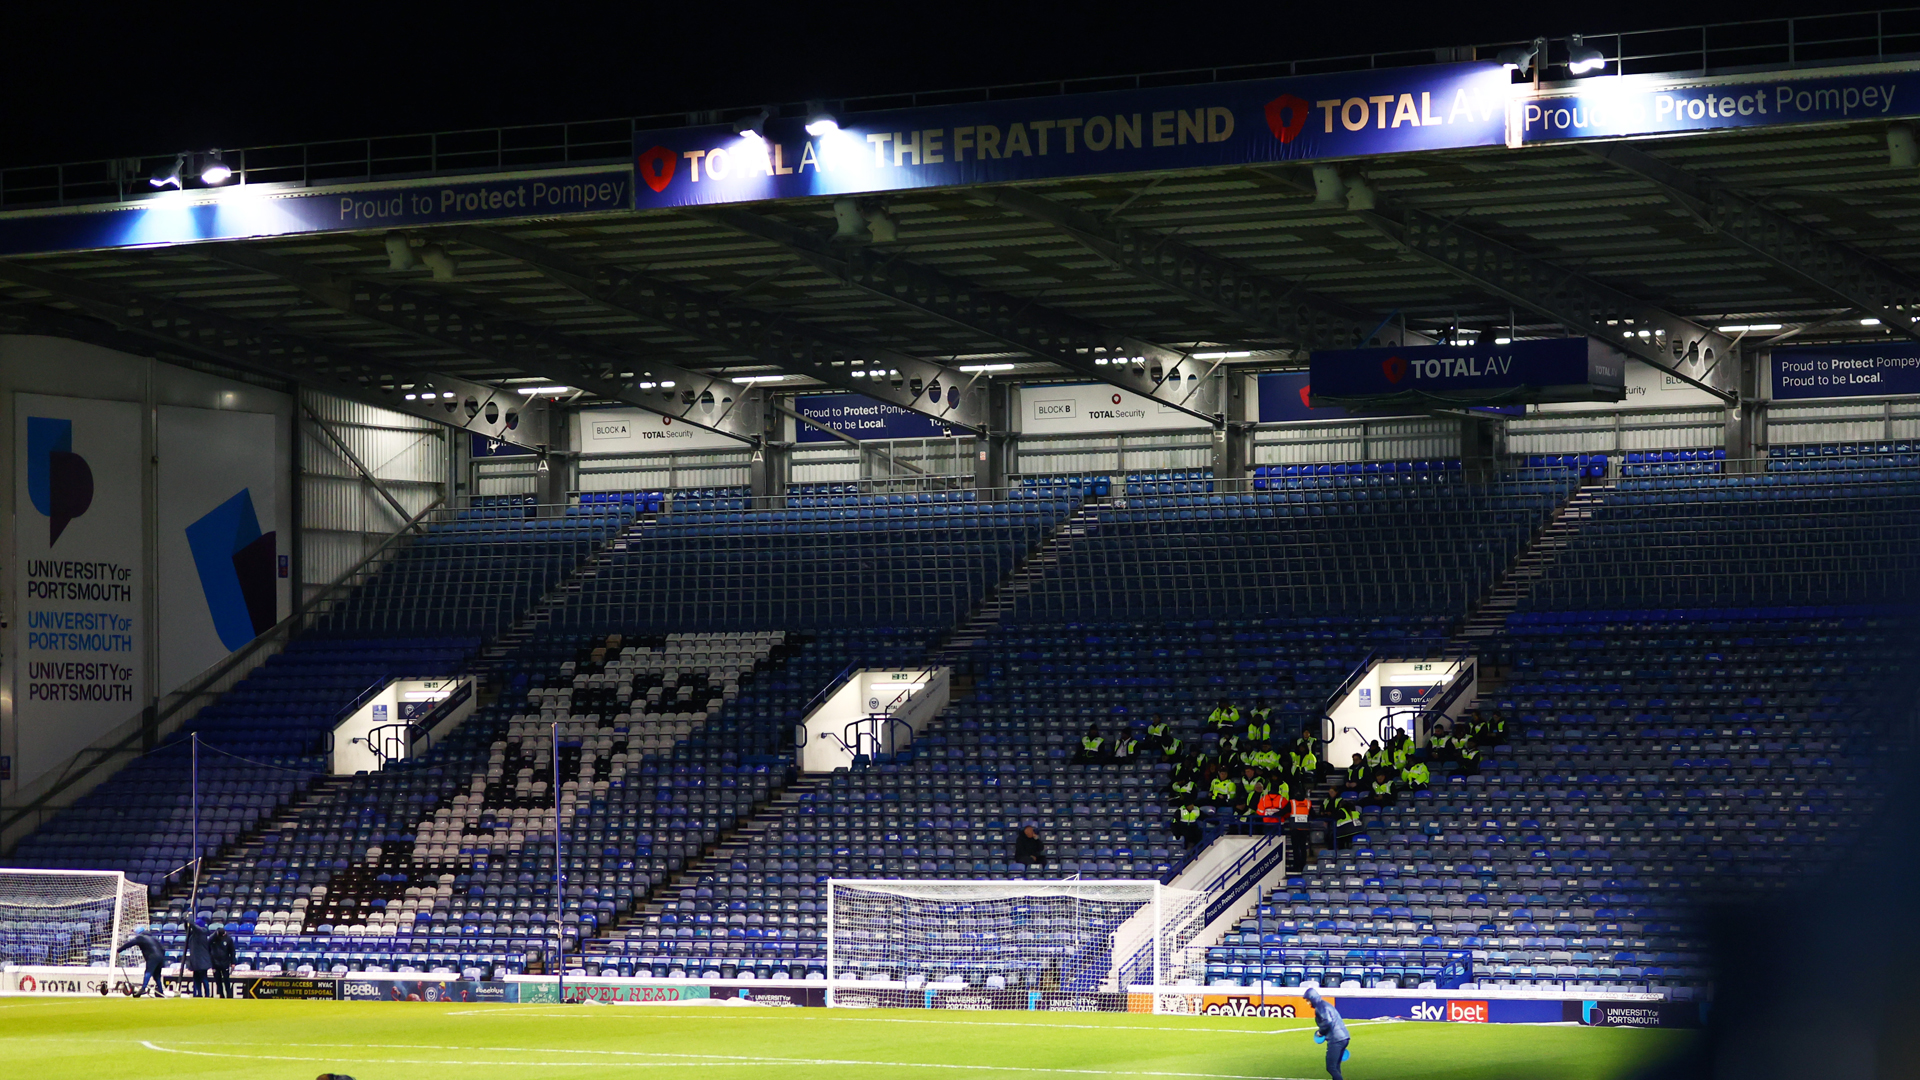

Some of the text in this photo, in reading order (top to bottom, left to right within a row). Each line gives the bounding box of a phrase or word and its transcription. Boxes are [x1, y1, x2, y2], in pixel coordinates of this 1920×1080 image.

[1655, 90, 1767, 122] Protect
[1776, 84, 1896, 115] Pompey
[1316, 91, 1442, 133] TOTAL
[866, 106, 1235, 168] THE FRATTON END
[683, 143, 793, 182] TOTAL
[340, 181, 625, 220] Proud to Protect Pompey
[1411, 355, 1513, 379] TOTAL AV
[1782, 356, 1920, 372] Proud to Protect Pompey
[1665, 376, 1688, 385] BLO
[1782, 372, 1884, 387] Proud to be Local.
[803, 407, 830, 418] Proud
[832, 407, 842, 417] to
[844, 405, 878, 416] Protect
[1038, 405, 1071, 415] BLOCK B
[1089, 408, 1145, 419] TOTAL Security
[596, 425, 627, 435] BLOCK A
[804, 418, 887, 431] Prod to be Local.
[642, 429, 693, 439] TOTAL Security
[28, 559, 117, 580] UNIVERSITY
[28, 580, 131, 602] PORTSMOUTH
[28, 611, 118, 631] UNIVERSITY
[29, 632, 132, 652] PORTSMOUTH
[29, 662, 119, 681] UNIVERSITY
[29, 682, 132, 702] PORTSMOUTH
[1221, 890, 1235, 906] Protect
[39, 980, 81, 993] TOTAL
[562, 986, 624, 1002] LEVEL
[629, 987, 680, 1002] HEAD
[1411, 1001, 1484, 1020] sky bet
[1607, 1008, 1652, 1016] UNIVERSITY
[1607, 1016, 1660, 1024] PORTSMOUTH
